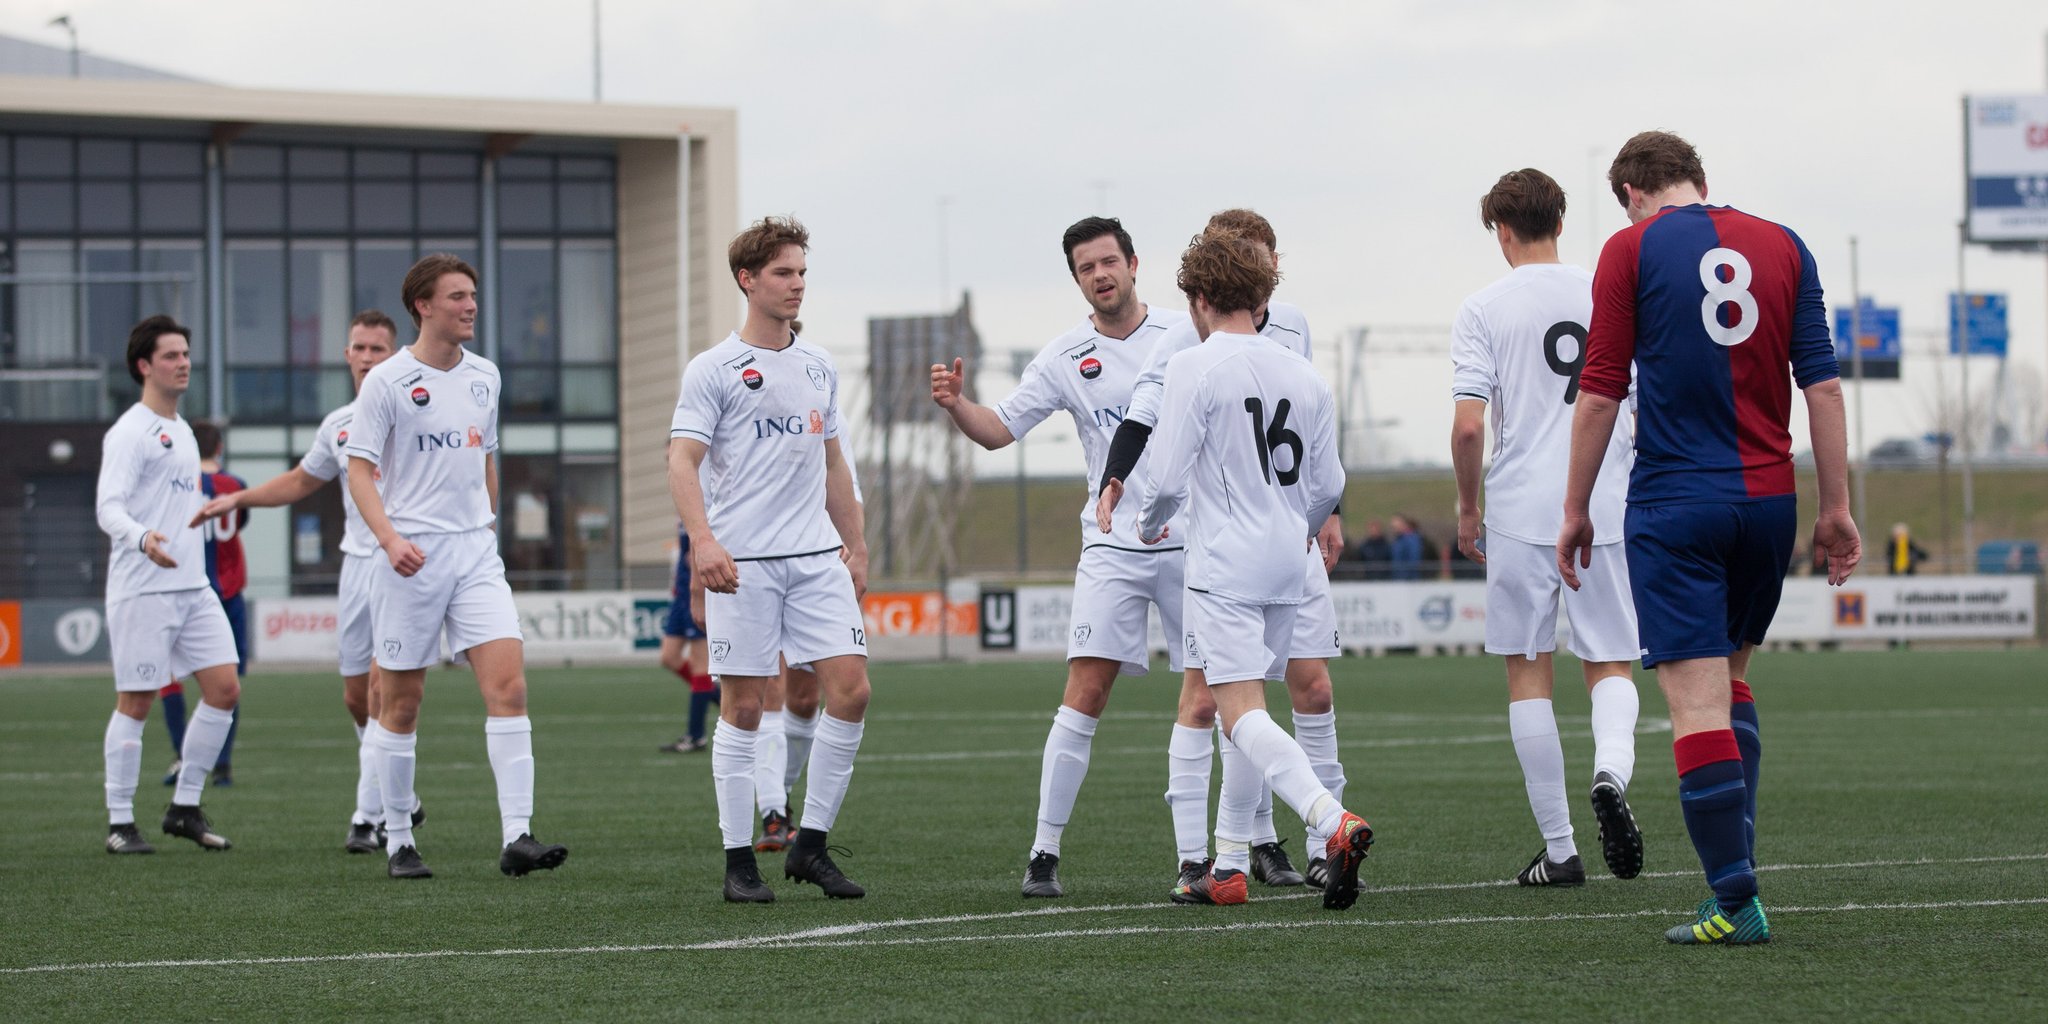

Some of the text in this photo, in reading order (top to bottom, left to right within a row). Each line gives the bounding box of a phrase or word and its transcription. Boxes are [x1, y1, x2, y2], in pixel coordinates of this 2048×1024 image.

[1699, 247, 1759, 346] 8
[1071, 343, 1097, 361] hummel
[732, 355, 757, 371] hummel
[1081, 362, 1099, 370] SPORT
[1084, 366, 1099, 375] 2000
[1543, 321, 1590, 405] 9
[743, 372, 760, 380] SPORT
[746, 377, 760, 385] 2000
[1093, 404, 1129, 427] IN
[753, 415, 804, 440] ING
[417, 430, 462, 452] ING
[1244, 397, 1304, 487] 16
[850, 627, 865, 646] 12
[1334, 630, 1340, 649] 8
